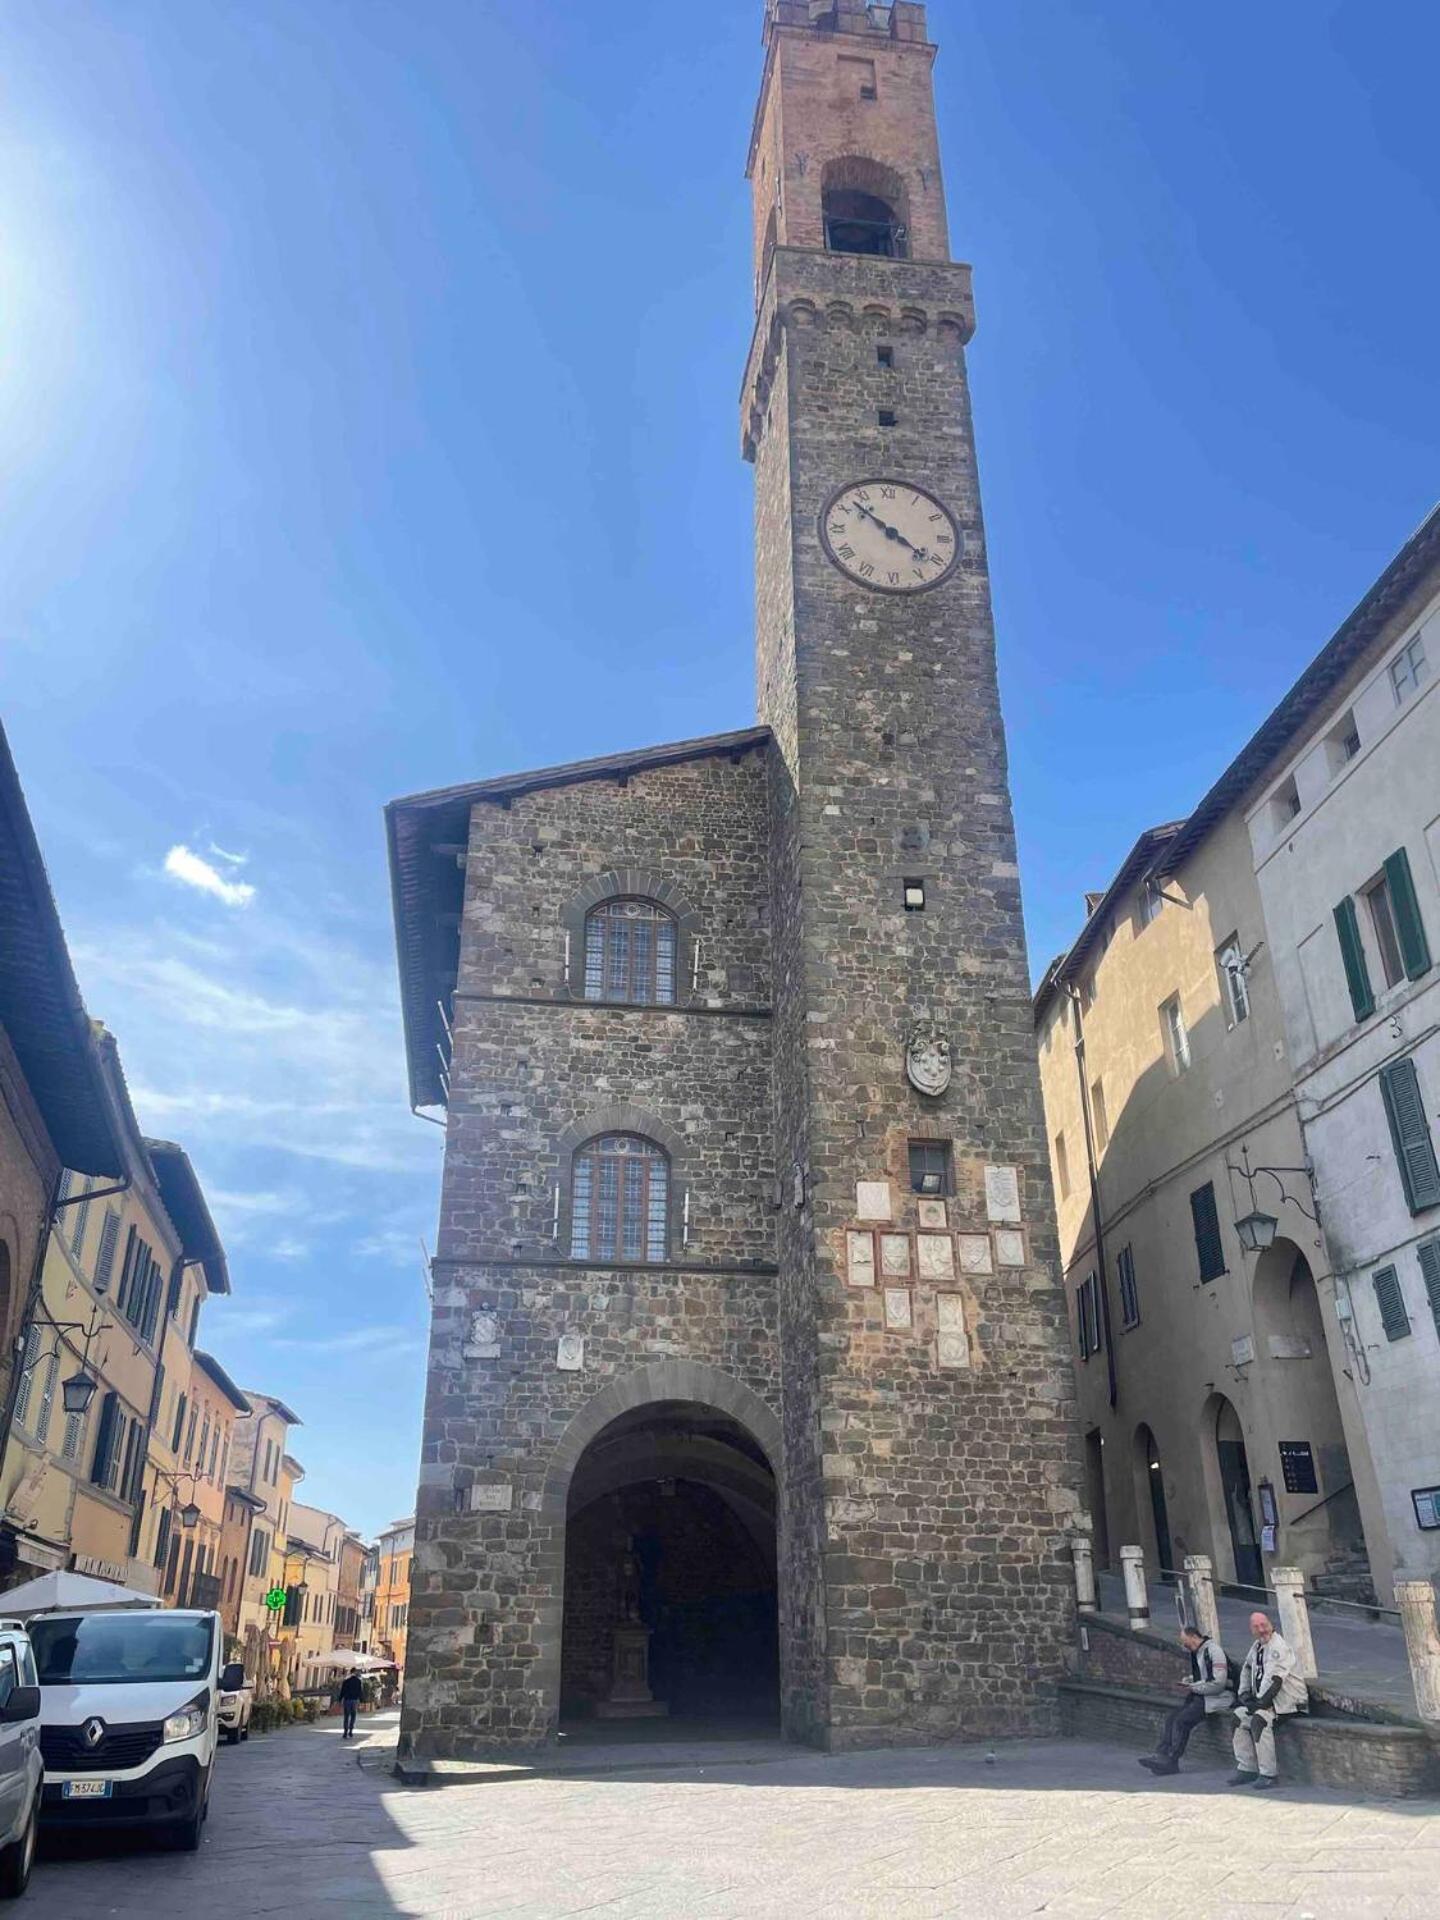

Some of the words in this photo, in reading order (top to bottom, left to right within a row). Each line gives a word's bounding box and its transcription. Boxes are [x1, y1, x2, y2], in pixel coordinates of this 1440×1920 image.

[855, 488, 870, 501] XI
[880, 486, 896, 500] XII
[911, 496, 920, 506] I
[837, 503, 851, 514] X
[928, 514, 943, 522] II
[829, 522, 845, 534] IX
[936, 535, 951, 544] III
[839, 543, 856, 560] VIII
[930, 553, 944, 567] IV
[859, 561, 875, 577] VII
[912, 568, 924, 579] V
[888, 571, 900, 584] VI
